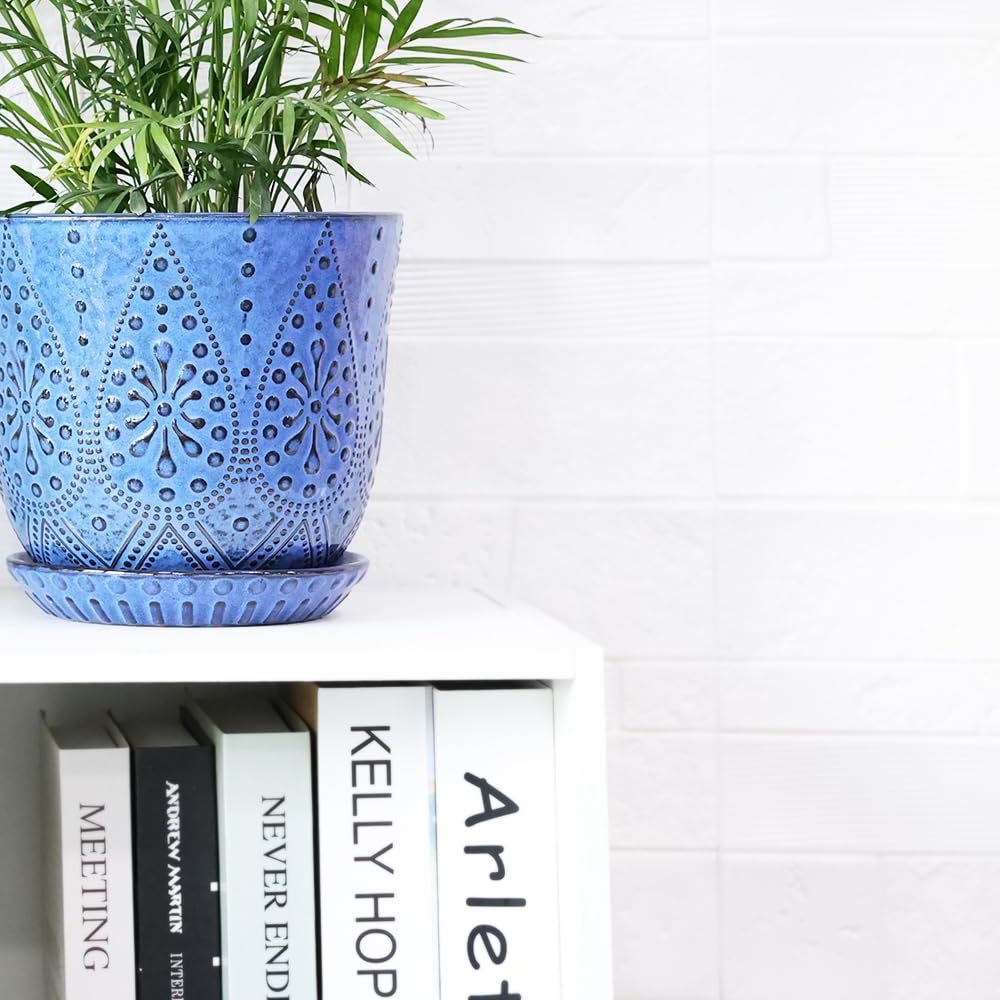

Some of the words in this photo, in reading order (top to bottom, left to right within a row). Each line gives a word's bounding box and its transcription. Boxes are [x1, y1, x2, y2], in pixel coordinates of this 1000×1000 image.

[165, 780, 181, 862] ANDREW
[261, 795, 288, 912] NEVER
[350, 725, 395, 875] KELLY
[79, 803, 110, 972] MEETING
[167, 863, 183, 934] MARTIN
[463, 771, 527, 1000] Arlet
[169, 952, 185, 1000] INTER
[354, 892, 398, 998] HOP
